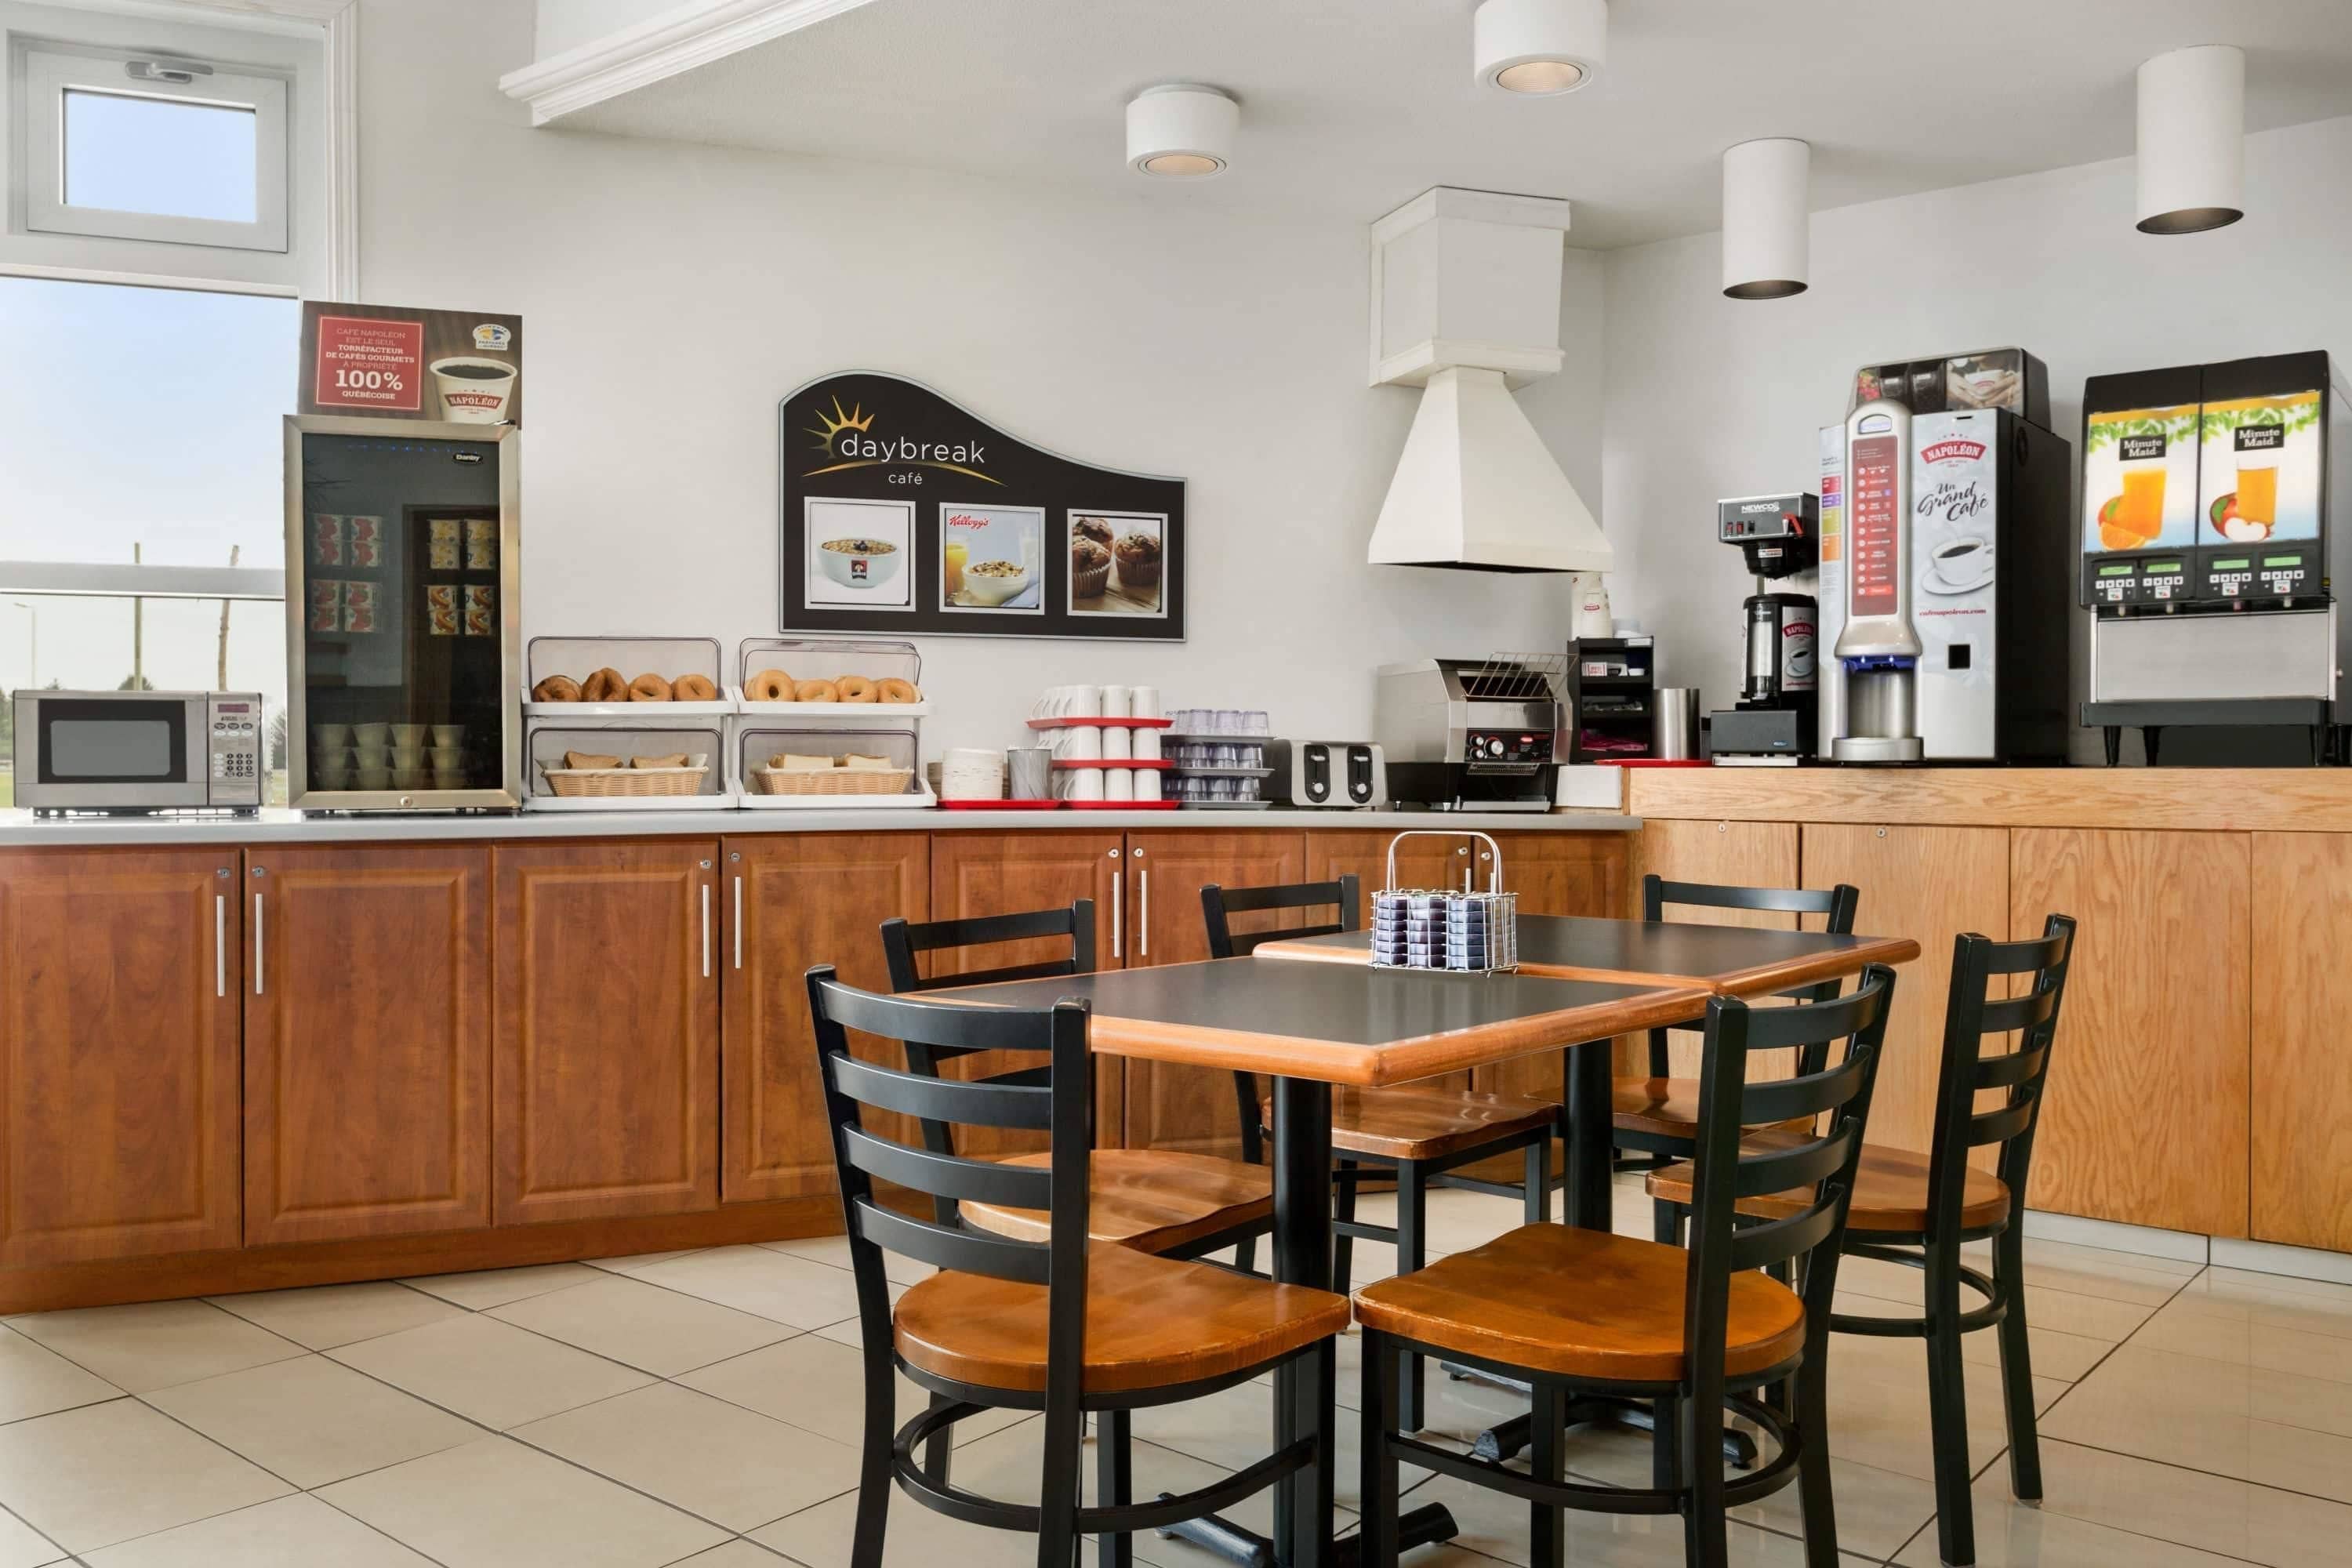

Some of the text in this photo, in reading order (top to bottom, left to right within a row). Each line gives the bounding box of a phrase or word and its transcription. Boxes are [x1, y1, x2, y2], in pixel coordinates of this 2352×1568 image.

[338, 344, 404, 354] TORRÉFACTEUR
[339, 351, 366, 360] CAFÉS
[368, 354, 415, 363] GOURMETS
[335, 369, 403, 390] 100%
[342, 390, 396, 400] QUÉBÉCOISE
[449, 395, 499, 407] NAPOLÉON
[2239, 428, 2280, 439] Minute
[841, 434, 985, 463] daybreak
[2124, 438, 2162, 449] Minute
[2245, 437, 2274, 448] Maid
[1927, 443, 1980, 461] NAPOLÉON
[2129, 448, 2157, 457] Maid
[888, 472, 923, 485] café
[1936, 483, 1956, 495] Un
[1918, 481, 1976, 516] Grand
[949, 514, 989, 529] Kellogg's
